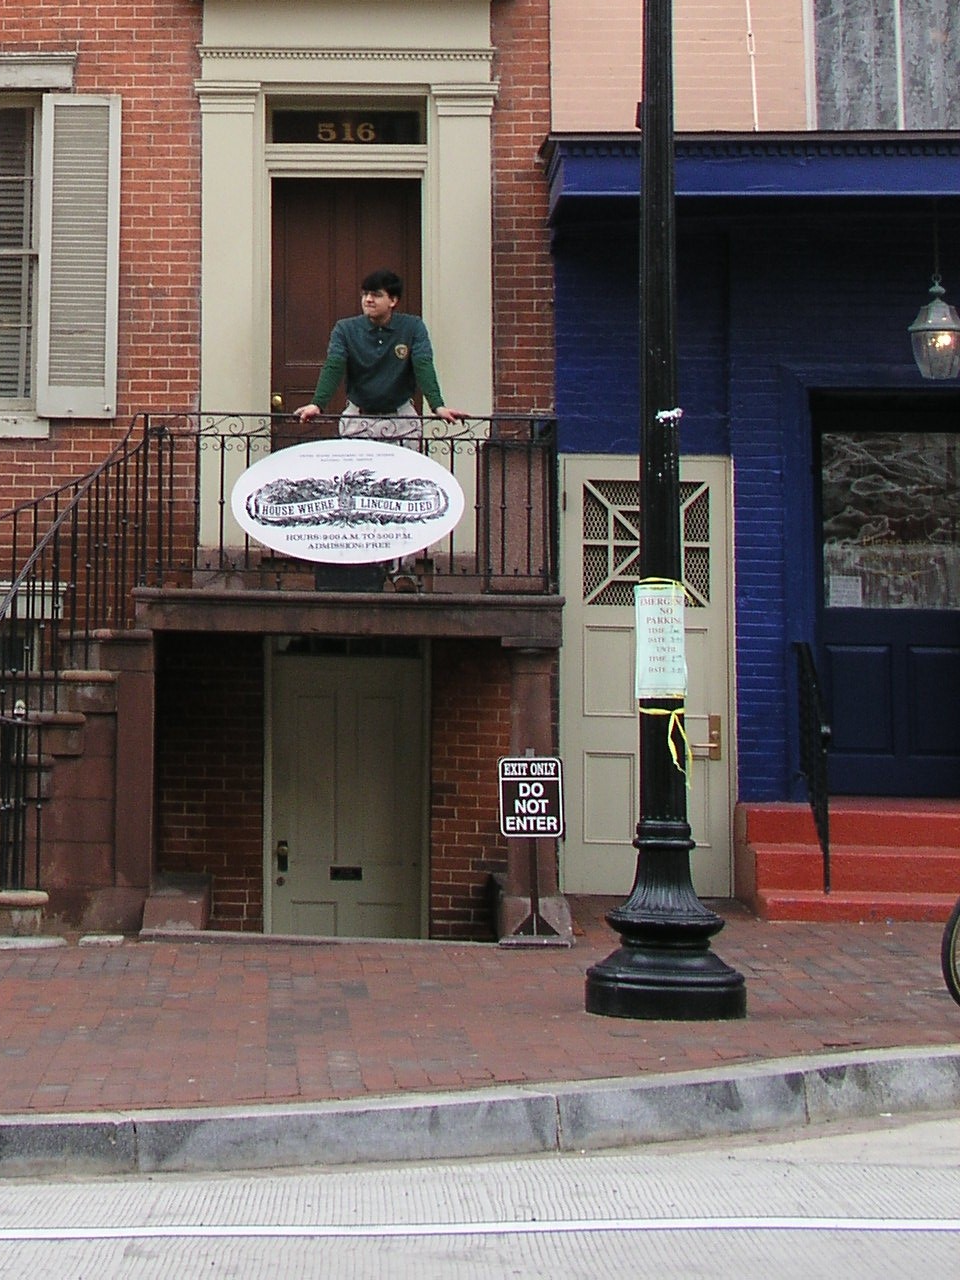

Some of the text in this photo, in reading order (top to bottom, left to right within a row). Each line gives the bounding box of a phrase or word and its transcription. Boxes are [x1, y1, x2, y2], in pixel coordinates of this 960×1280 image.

[317, 122, 376, 142] 516
[261, 498, 433, 516] HOUSE WHERE LINCOLN DIED
[659, 607, 673, 615] NO
[646, 616, 681, 624] PARKIN
[503, 762, 556, 776] EXIT ONLY
[518, 782, 544, 798] DO
[514, 799, 549, 814] NOT
[505, 816, 558, 831] ENTER
